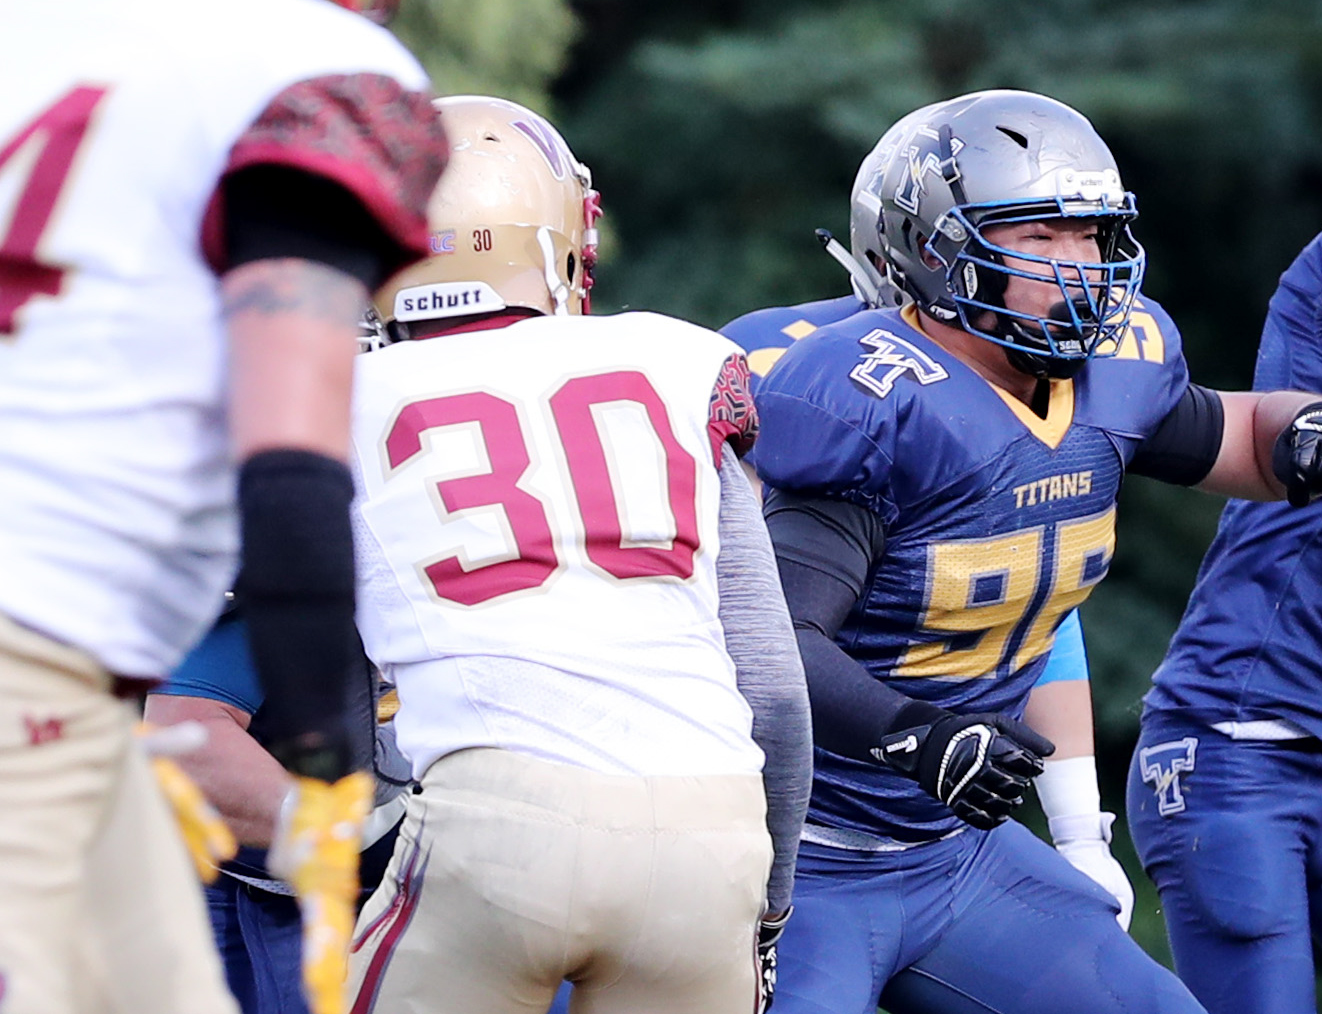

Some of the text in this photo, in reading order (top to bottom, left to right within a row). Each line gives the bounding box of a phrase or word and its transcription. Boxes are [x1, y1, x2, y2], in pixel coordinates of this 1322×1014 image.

[473, 228, 492, 253] 30
[404, 288, 482, 312] schutt
[380, 366, 705, 611] 30
[1013, 470, 1094, 509] TITANS
[1140, 737, 1199, 817] T
